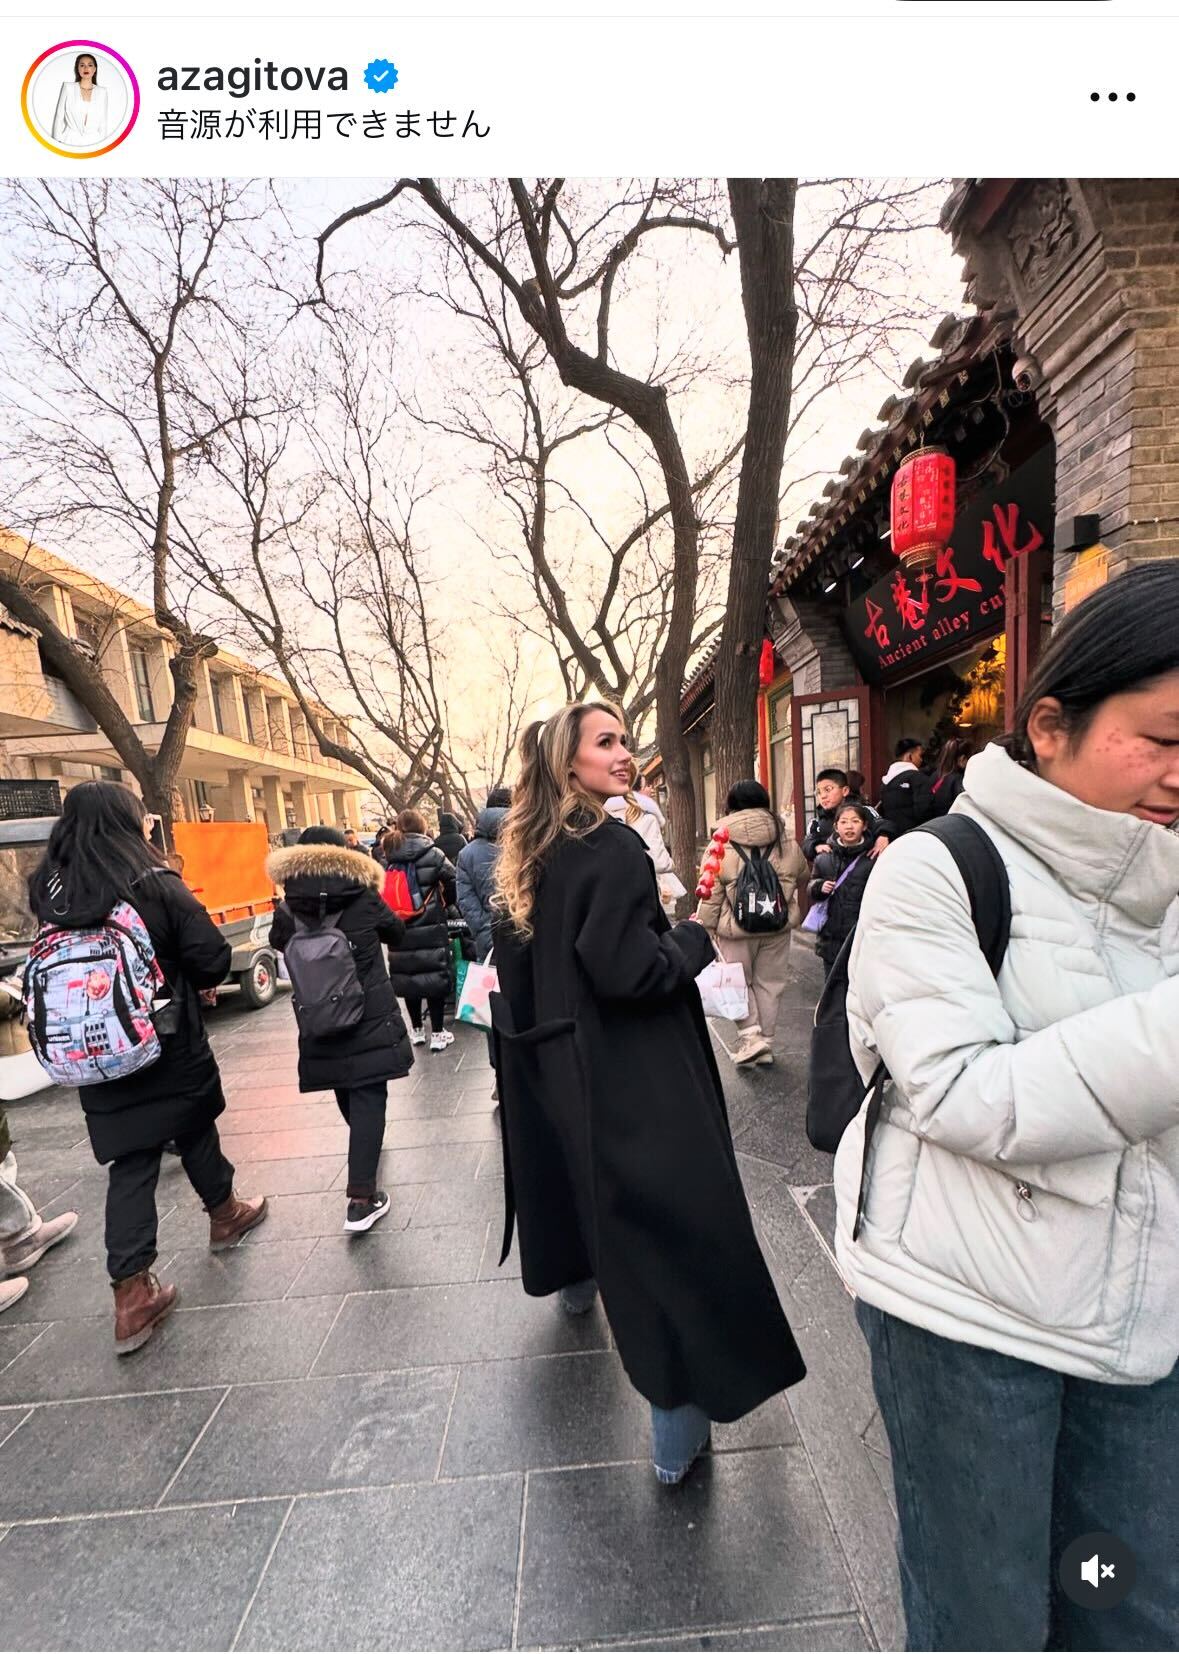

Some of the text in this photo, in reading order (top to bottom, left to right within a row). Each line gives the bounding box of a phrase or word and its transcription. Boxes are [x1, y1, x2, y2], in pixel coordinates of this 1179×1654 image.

[864, 503, 1044, 648] 古巷文化
[879, 635, 928, 668] Ancient
[932, 611, 970, 641] alley
